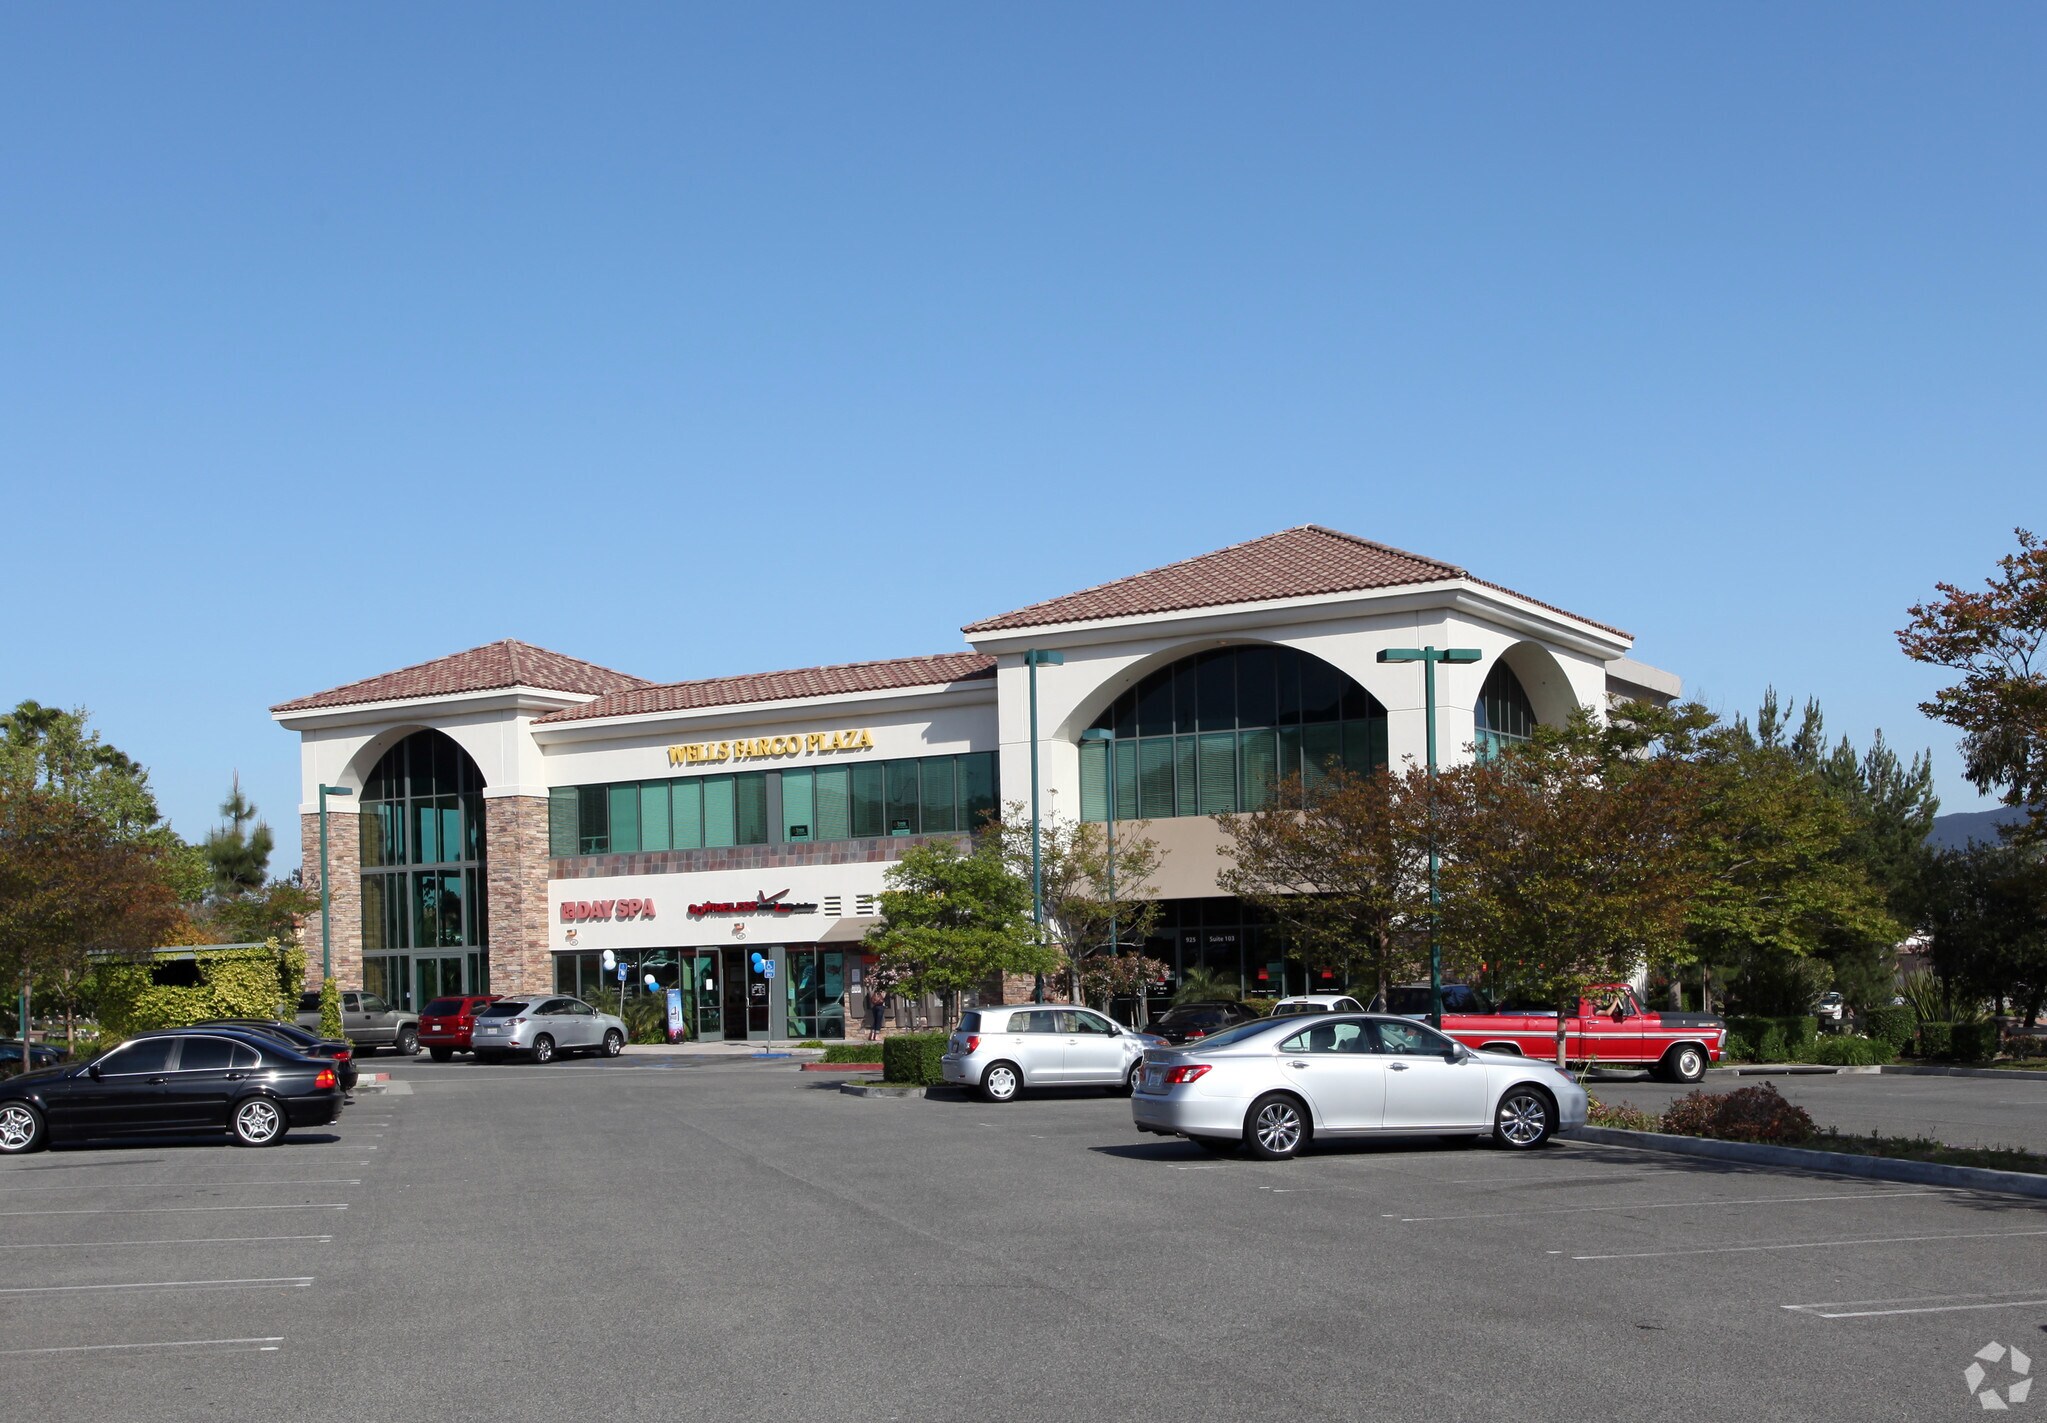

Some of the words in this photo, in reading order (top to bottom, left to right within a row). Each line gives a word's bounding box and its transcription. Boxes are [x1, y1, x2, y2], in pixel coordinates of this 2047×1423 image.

[668, 742, 731, 765] WELLS
[735, 735, 803, 758] FARGO
[807, 729, 874, 751] PLAZA
[576, 900, 615, 919] DAY
[616, 898, 656, 918] SPA
